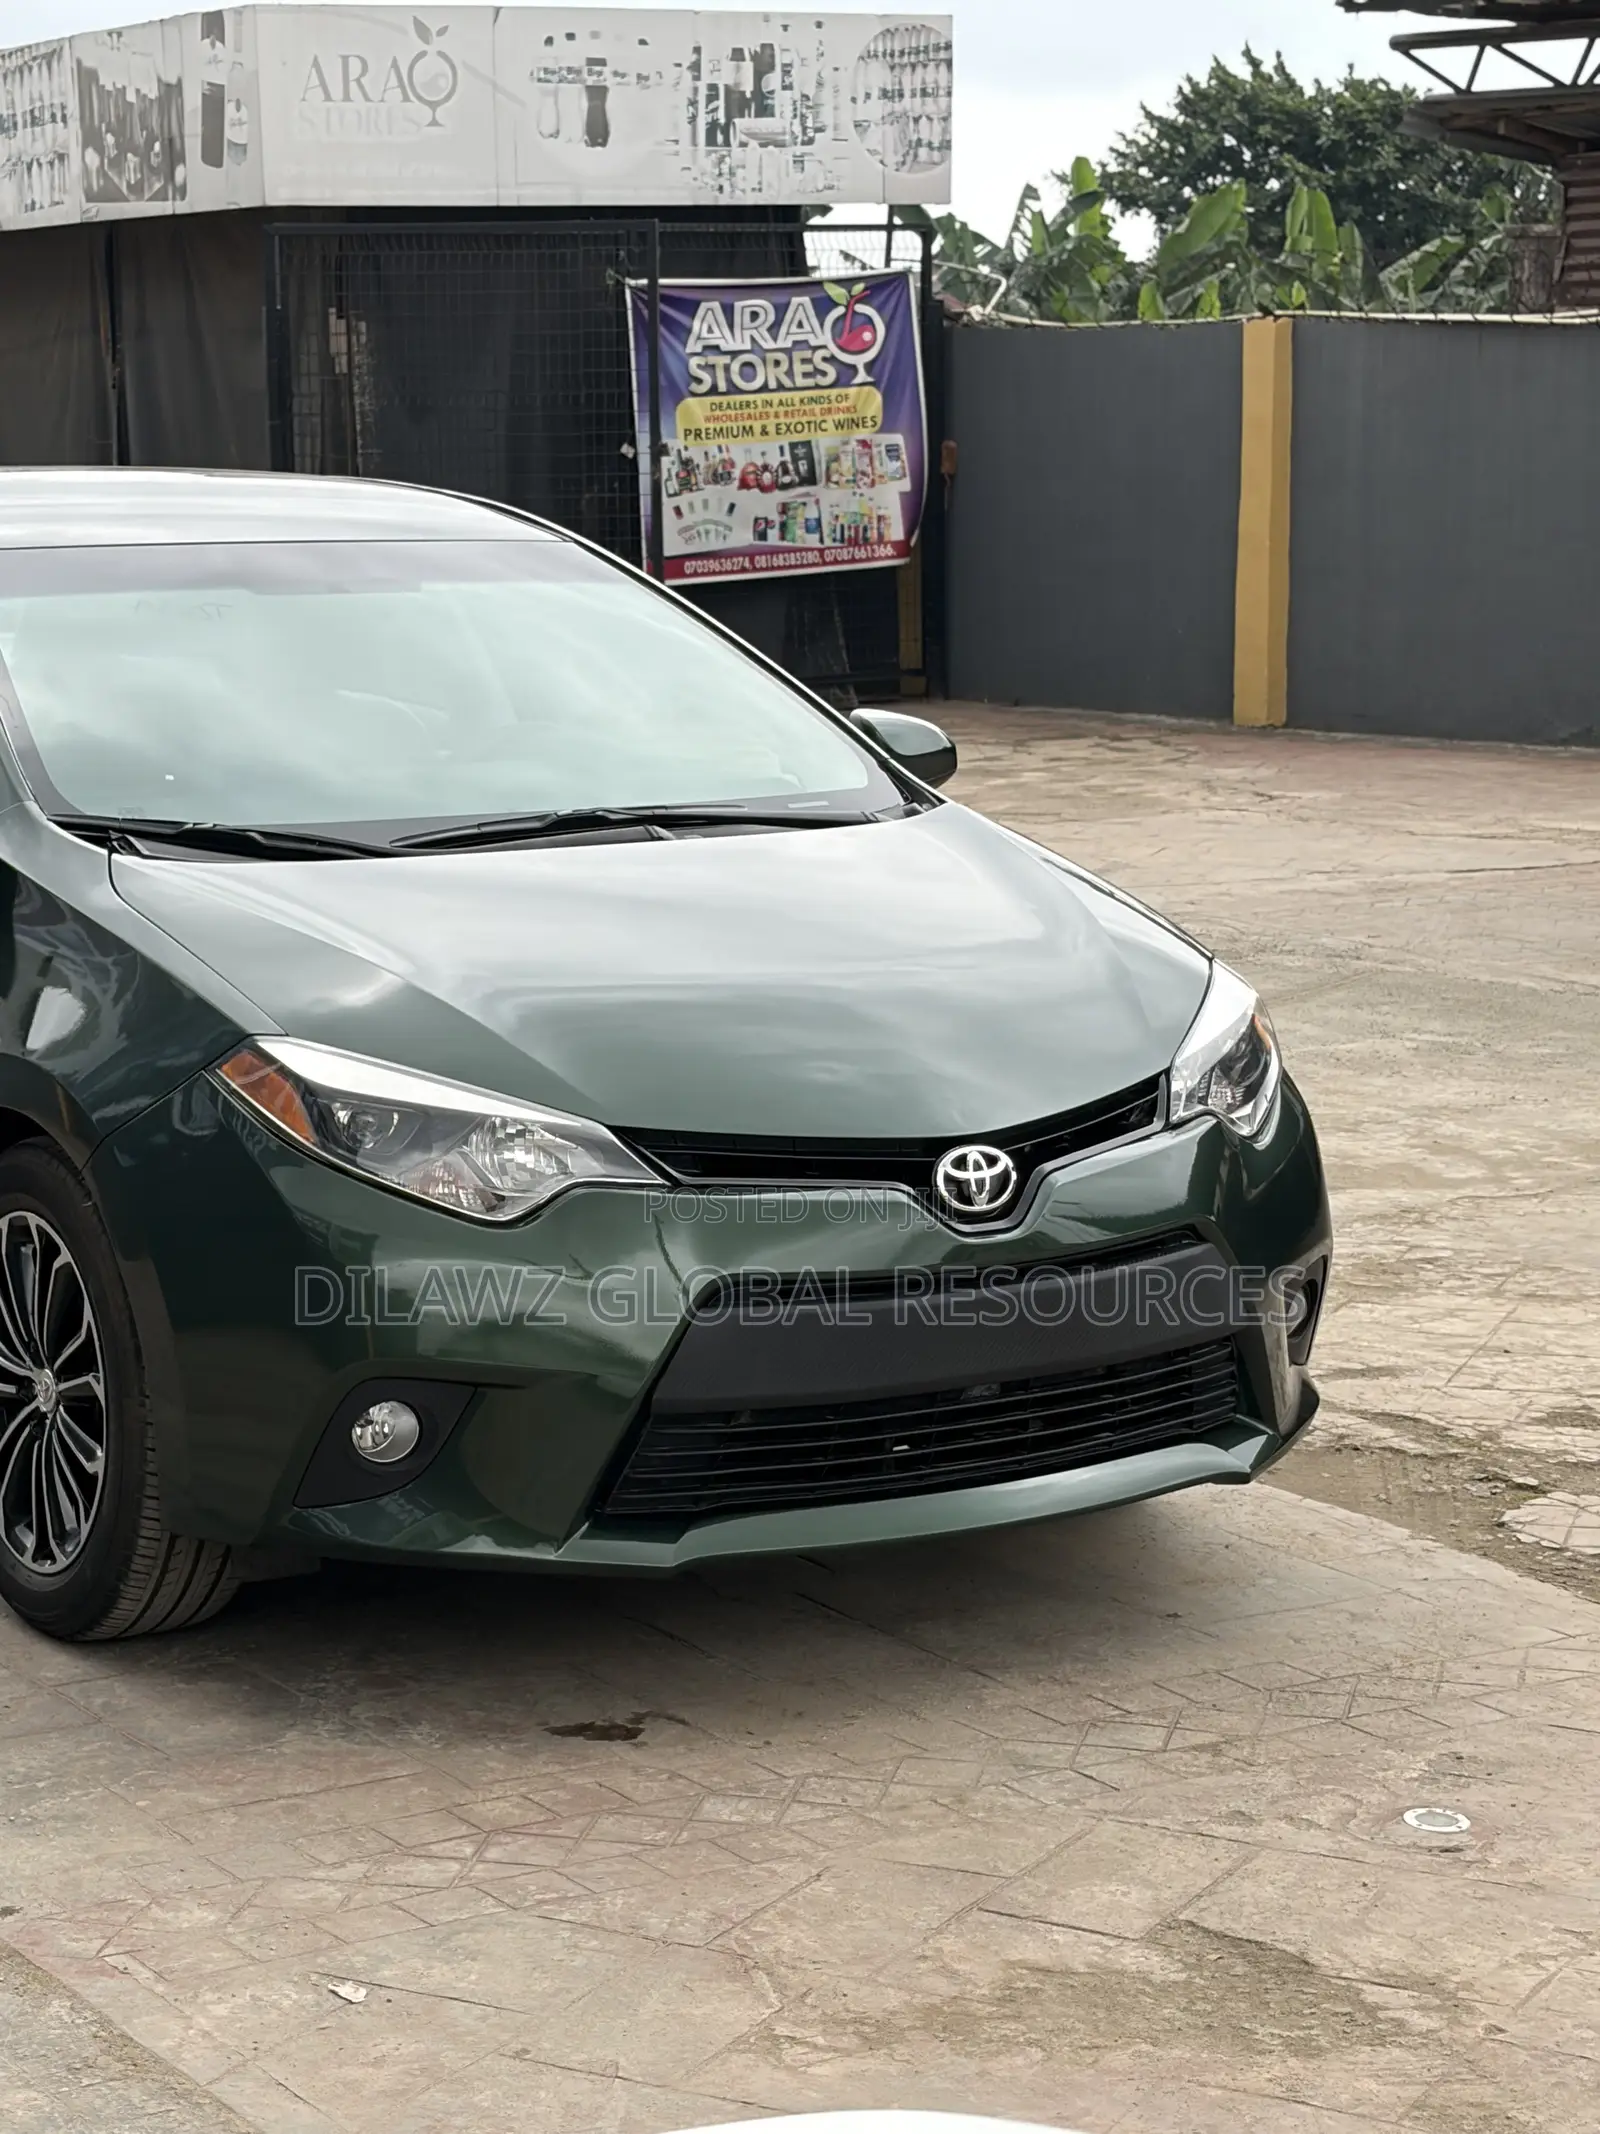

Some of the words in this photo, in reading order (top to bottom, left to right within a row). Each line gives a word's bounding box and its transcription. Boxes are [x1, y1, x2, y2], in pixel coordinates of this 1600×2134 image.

[688, 350, 837, 394] STORES
[703, 412, 770, 424] WHOLESALES
[783, 407, 816, 419] RETAIL
[819, 405, 858, 415] DRINKS
[709, 400, 758, 413] DEALERS
[761, 399, 774, 408] IN
[777, 397, 796, 408] ALL
[799, 395, 832, 406] KINDS
[835, 394, 850, 403] OF
[683, 425, 755, 442] PREMIUM
[760, 423, 769, 436] &
[775, 420, 828, 435] EXOTIC
[833, 415, 878, 431] WINES
